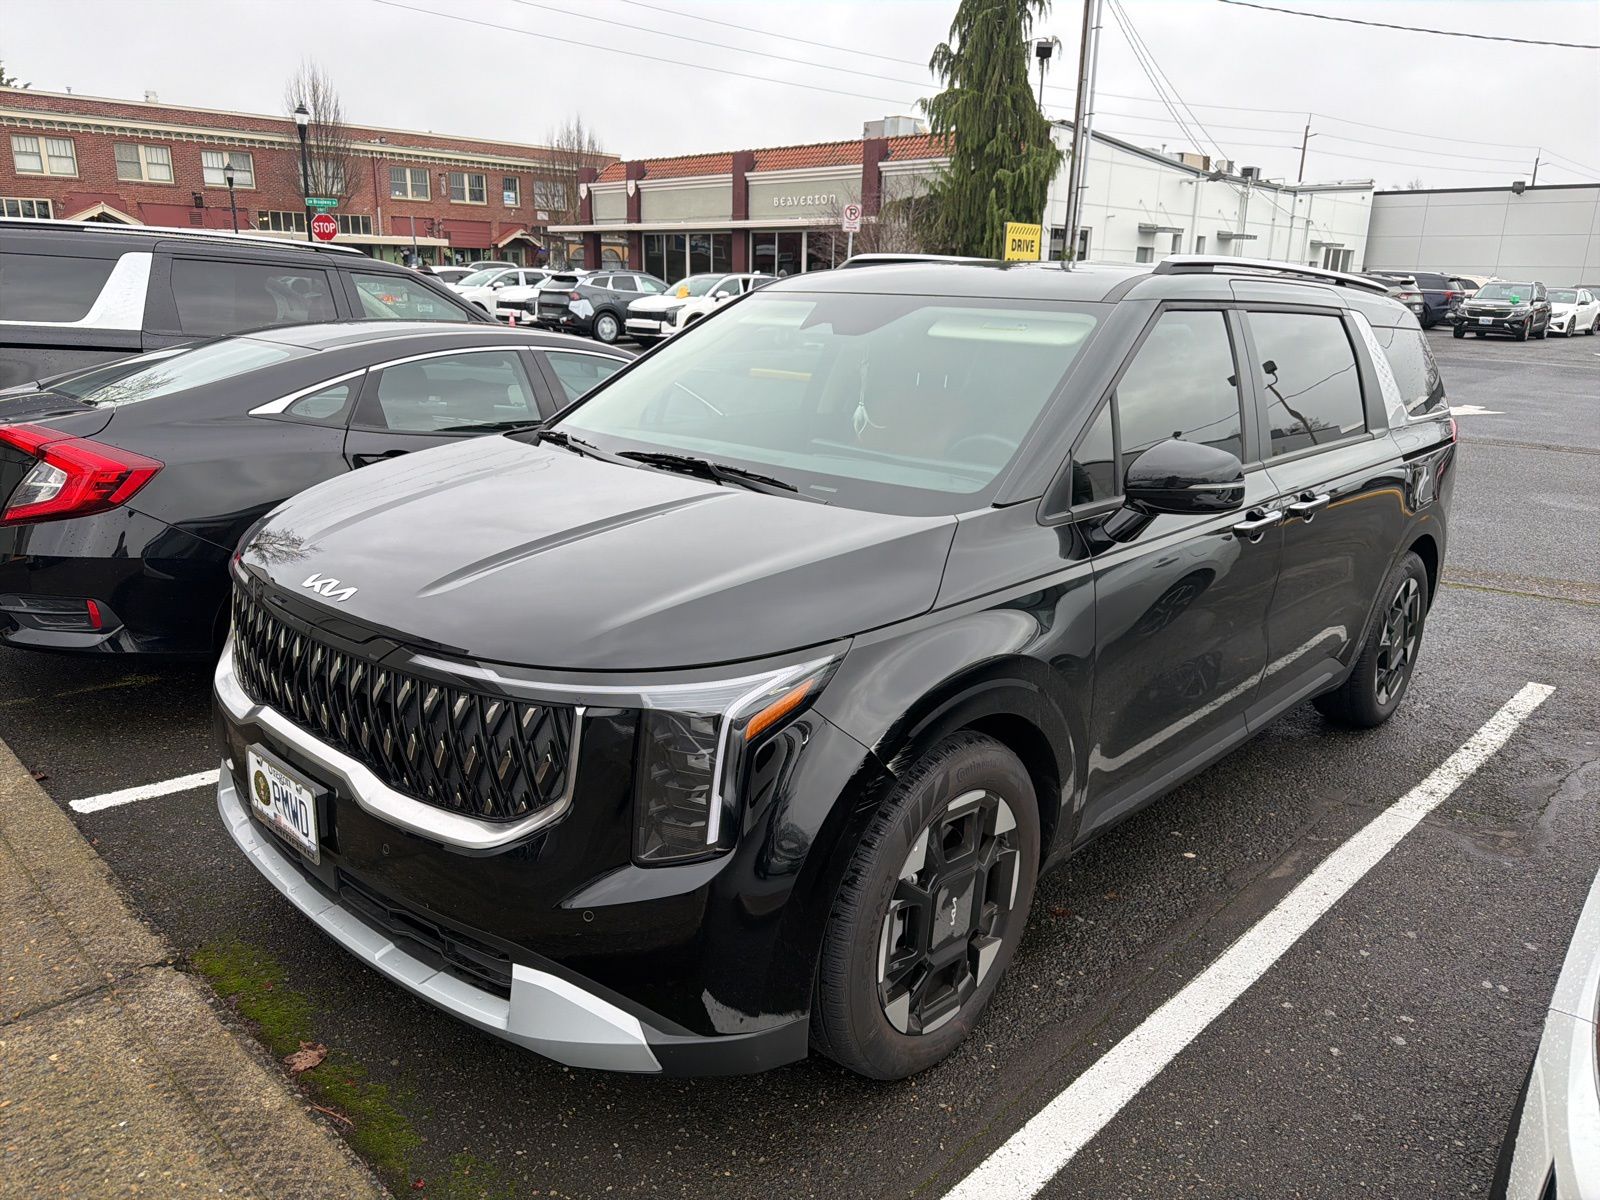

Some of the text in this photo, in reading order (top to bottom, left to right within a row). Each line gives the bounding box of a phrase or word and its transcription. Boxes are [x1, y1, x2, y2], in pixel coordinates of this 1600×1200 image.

[773, 193, 836, 207] BEAVERTON
[313, 222, 336, 233] STOP
[1011, 238, 1035, 253] DRIVE
[272, 780, 310, 838] PMWD
